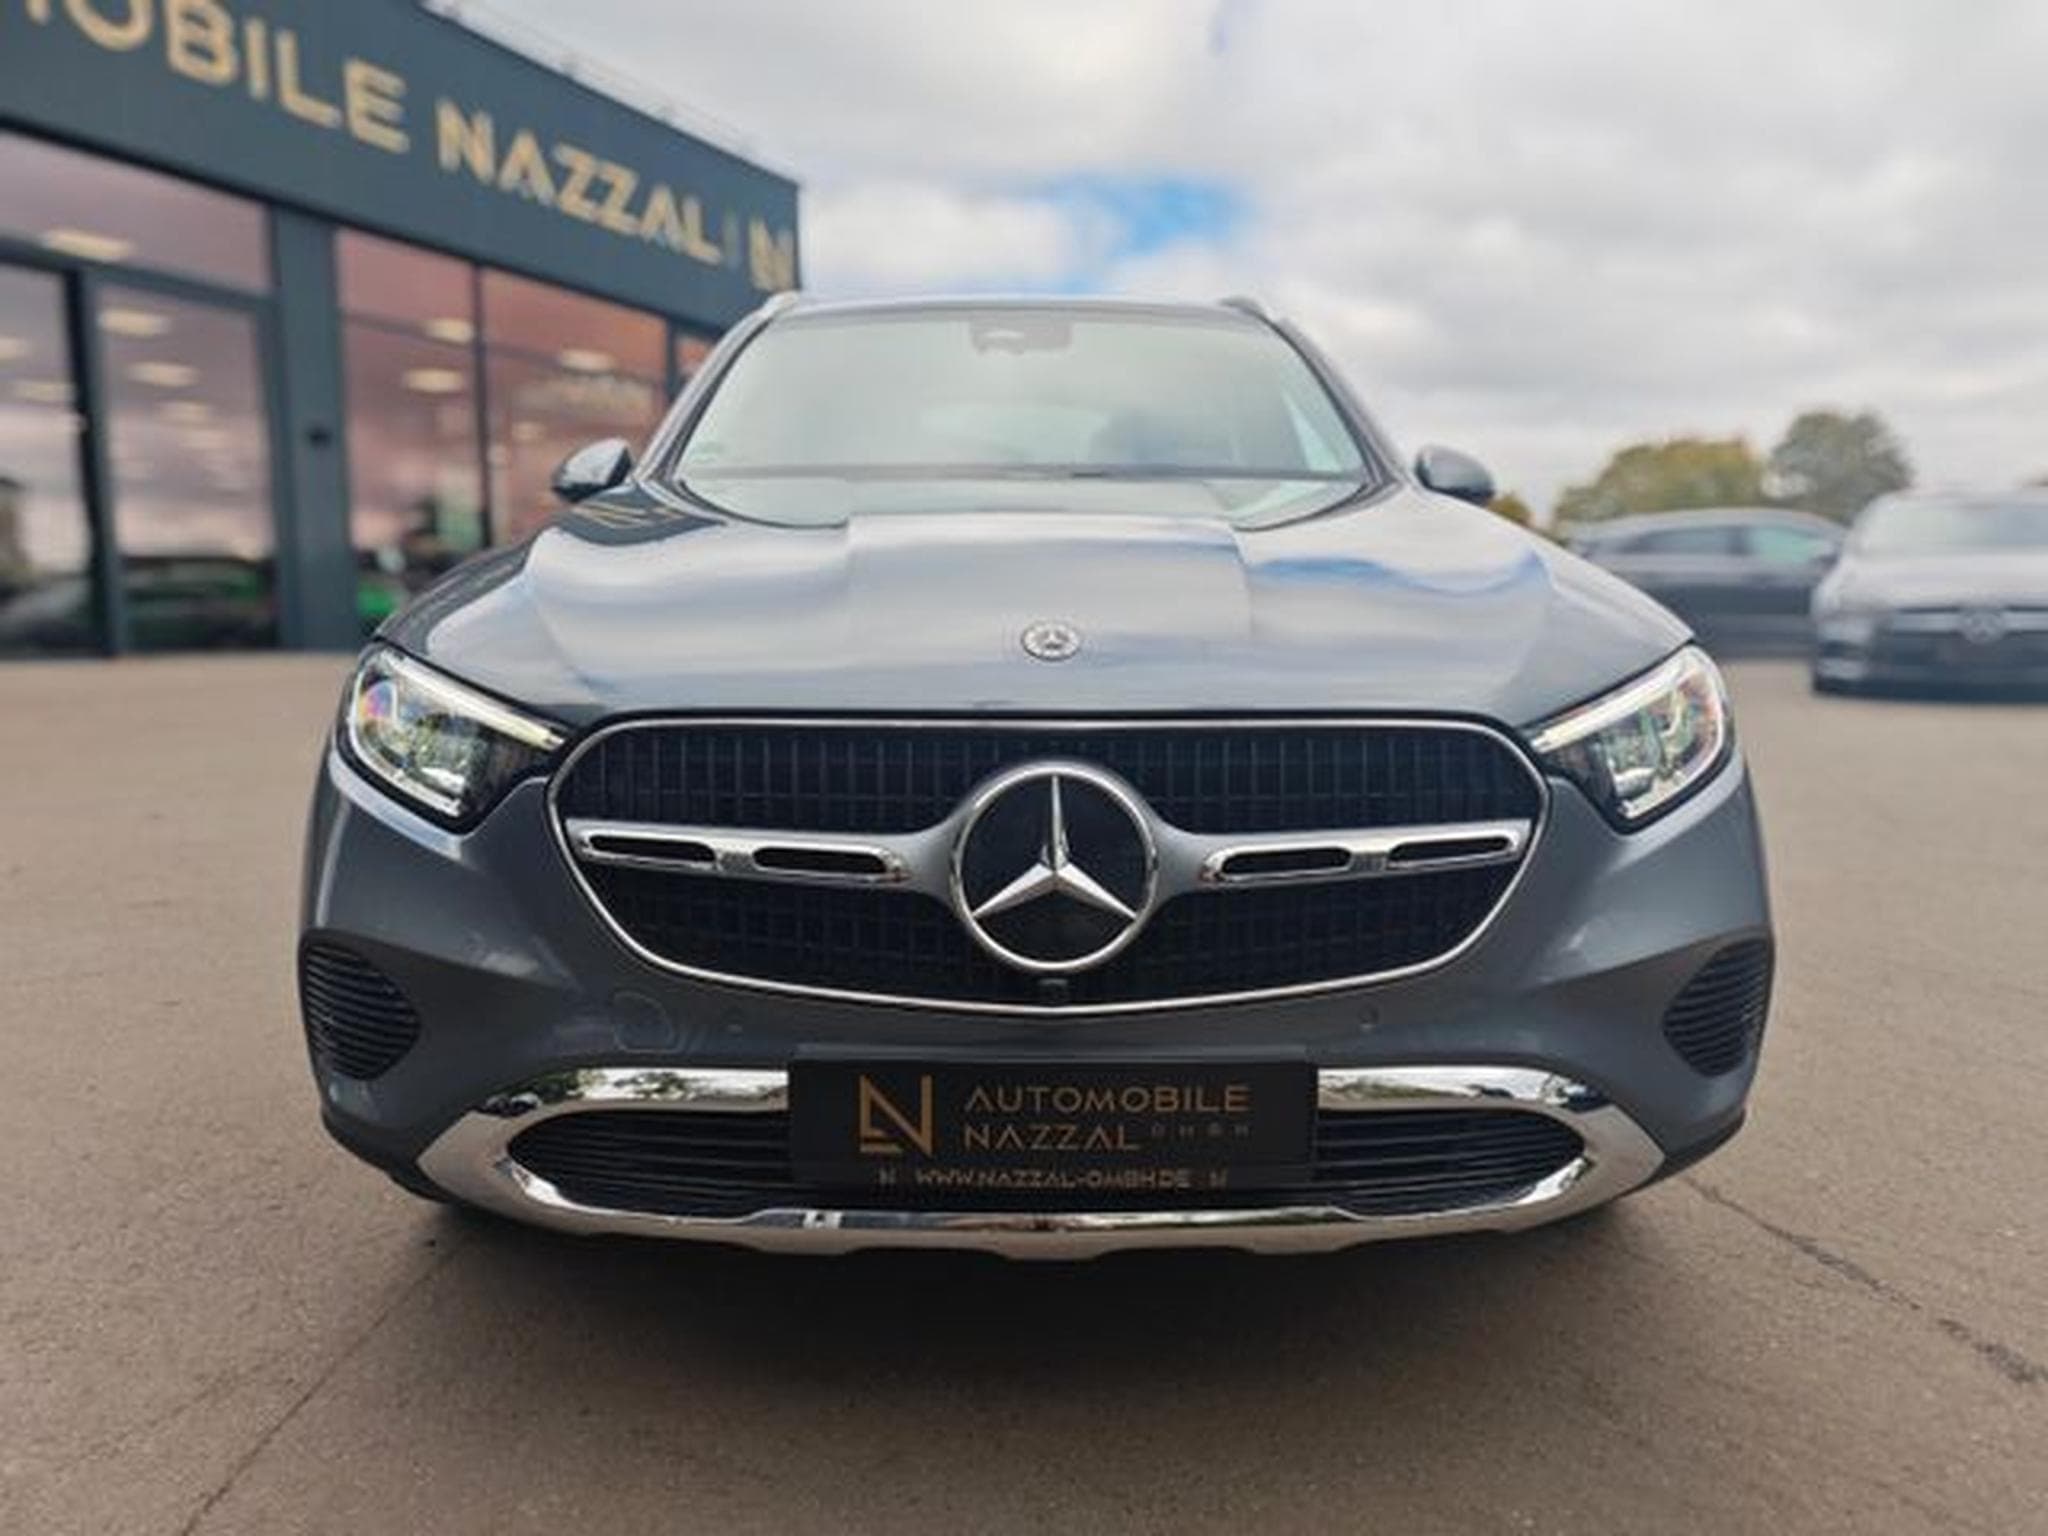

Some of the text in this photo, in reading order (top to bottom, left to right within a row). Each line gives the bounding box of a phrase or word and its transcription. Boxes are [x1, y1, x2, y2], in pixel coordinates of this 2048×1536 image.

[26, 0, 411, 154] OBILE
[435, 96, 722, 264] NAZZAL
[963, 1084, 1251, 1114] AUTOMOBILE
[965, 1124, 1140, 1152] NAZZAL
